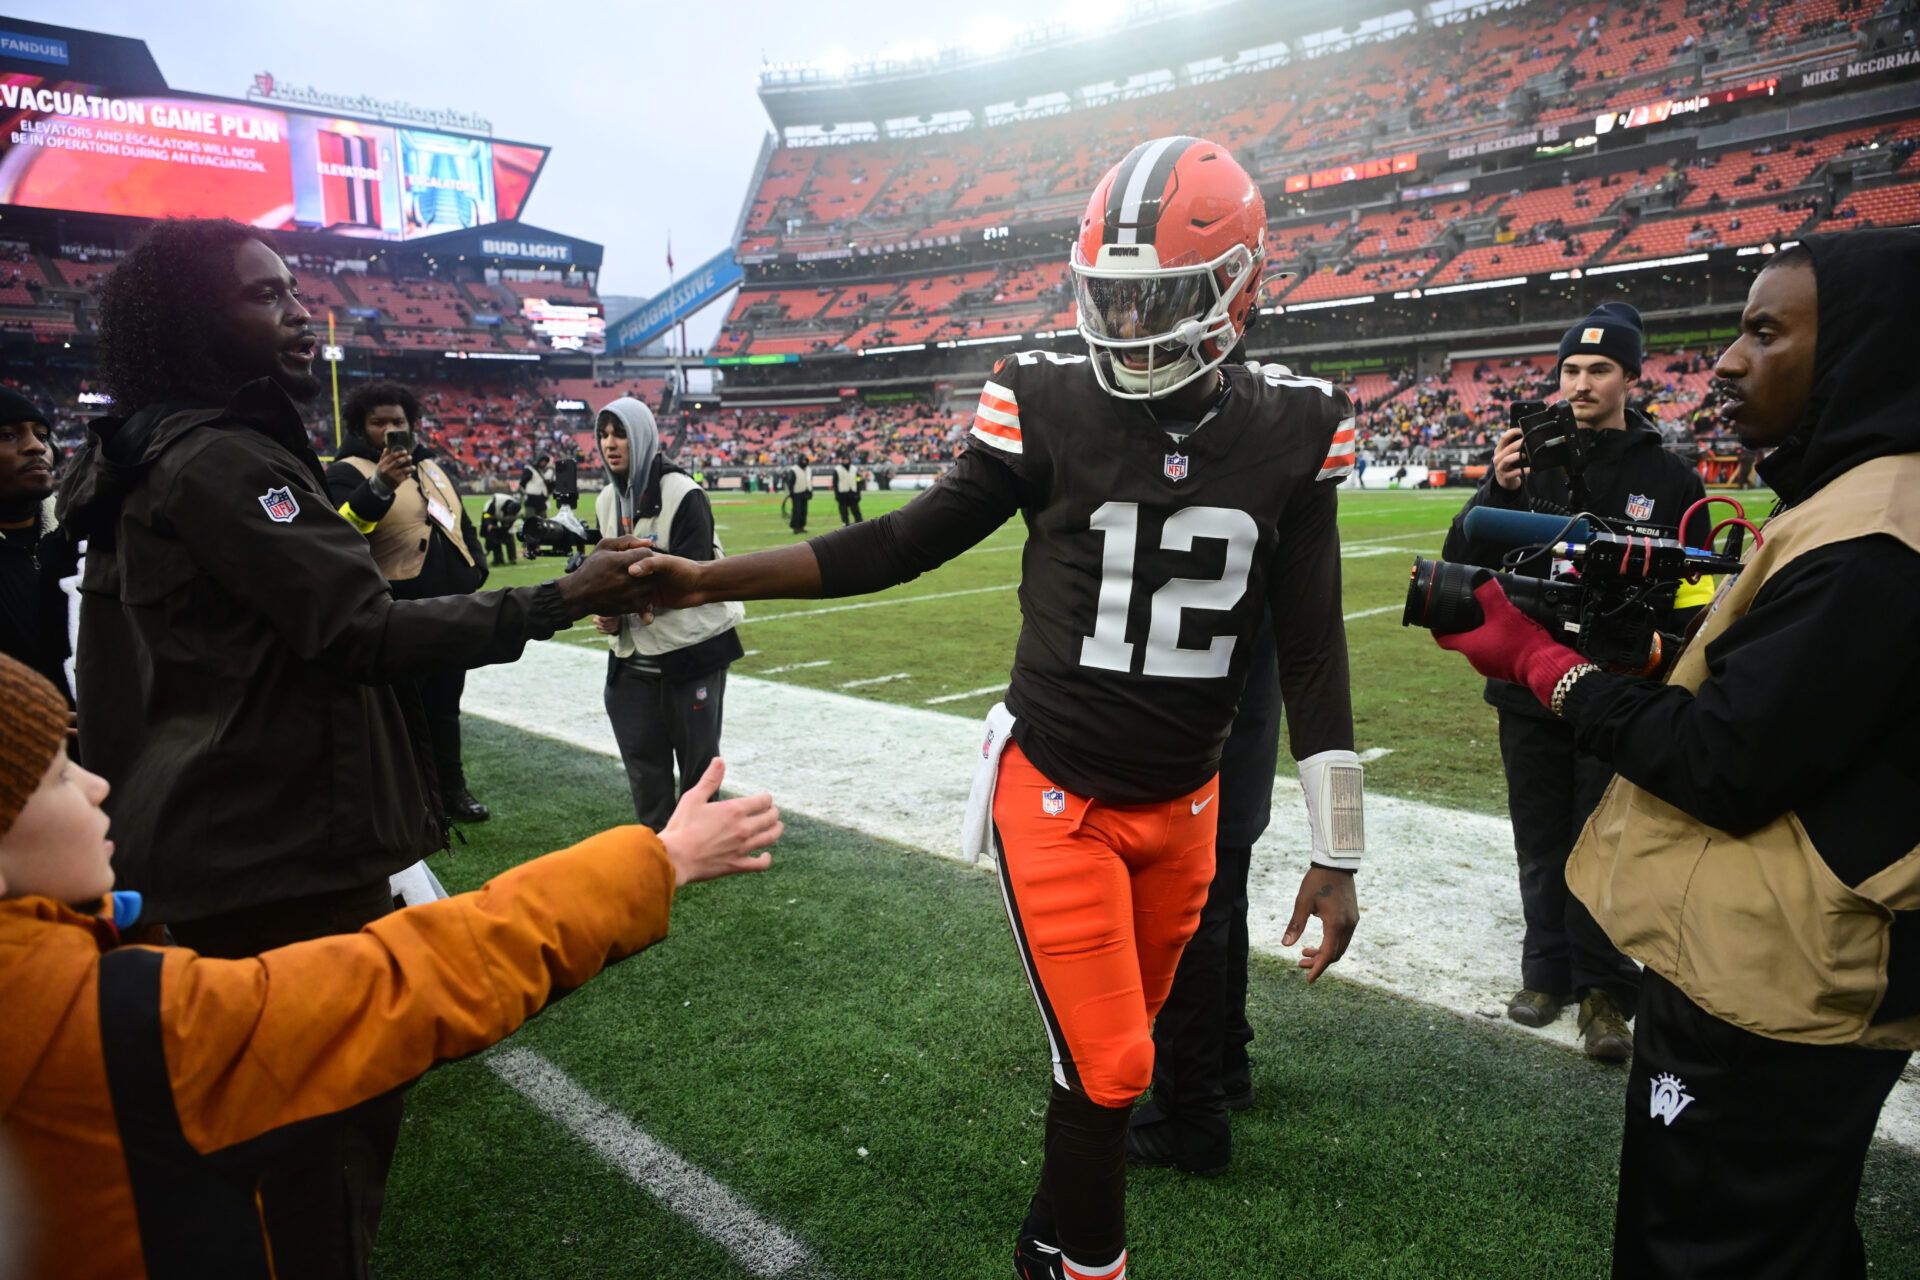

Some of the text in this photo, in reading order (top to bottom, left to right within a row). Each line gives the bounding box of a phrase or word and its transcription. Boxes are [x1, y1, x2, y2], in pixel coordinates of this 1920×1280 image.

[1, 38, 68, 58] FANDUEL
[1802, 67, 1840, 88] MIKE
[0, 84, 280, 143] VACUATION GAME PLAN
[11, 131, 28, 144] BE
[30, 134, 44, 147] IN
[46, 136, 119, 155] OPERATION
[121, 145, 169, 162] DURING
[171, 151, 189, 164] AN
[20, 119, 257, 160] ELEVATORS AND ESCALATORS WILL NOT
[316, 161, 384, 180] ELEVATORS
[482, 239, 568, 260] BUD LIGHT
[1109, 247, 1140, 257] BROWNS
[619, 268, 716, 349] PROGRESSIVE
[1168, 465, 1185, 476] NFL
[270, 499, 295, 518] NFL
[1628, 502, 1649, 518] NFL
[1635, 526, 1660, 537] MEDIA
[1080, 501, 1259, 679] 12
[1046, 799, 1063, 811] NFL
